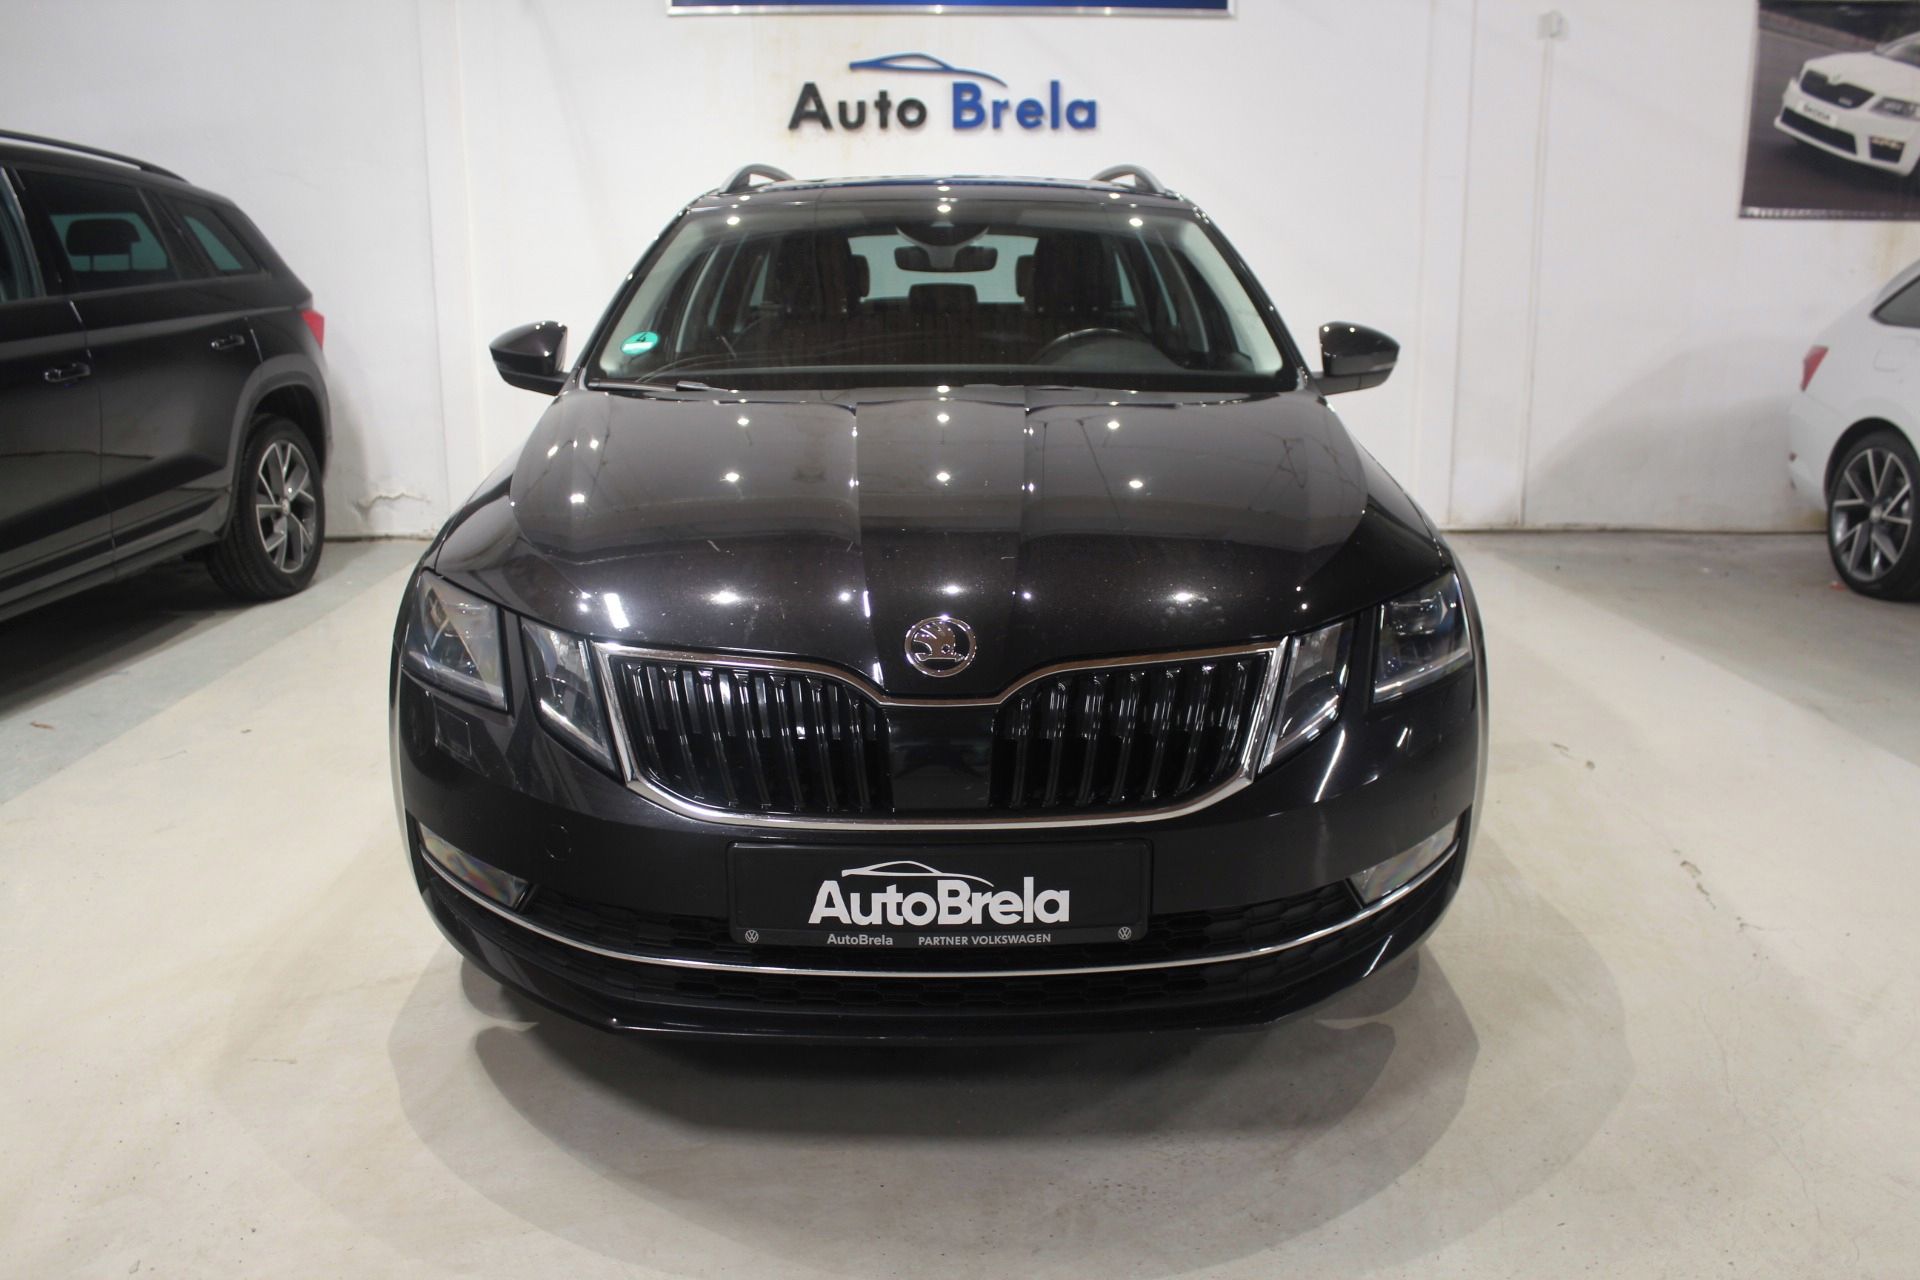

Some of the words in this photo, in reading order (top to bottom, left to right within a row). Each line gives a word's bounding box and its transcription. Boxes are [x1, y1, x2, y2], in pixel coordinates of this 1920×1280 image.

[788, 82, 928, 131] Auto
[953, 80, 1097, 131] Brela
[808, 876, 1070, 926] AutoBrela
[826, 933, 894, 946] AutoBrela
[918, 935, 969, 946] PARTNER
[971, 933, 1051, 945] VOLKSWAGEN
